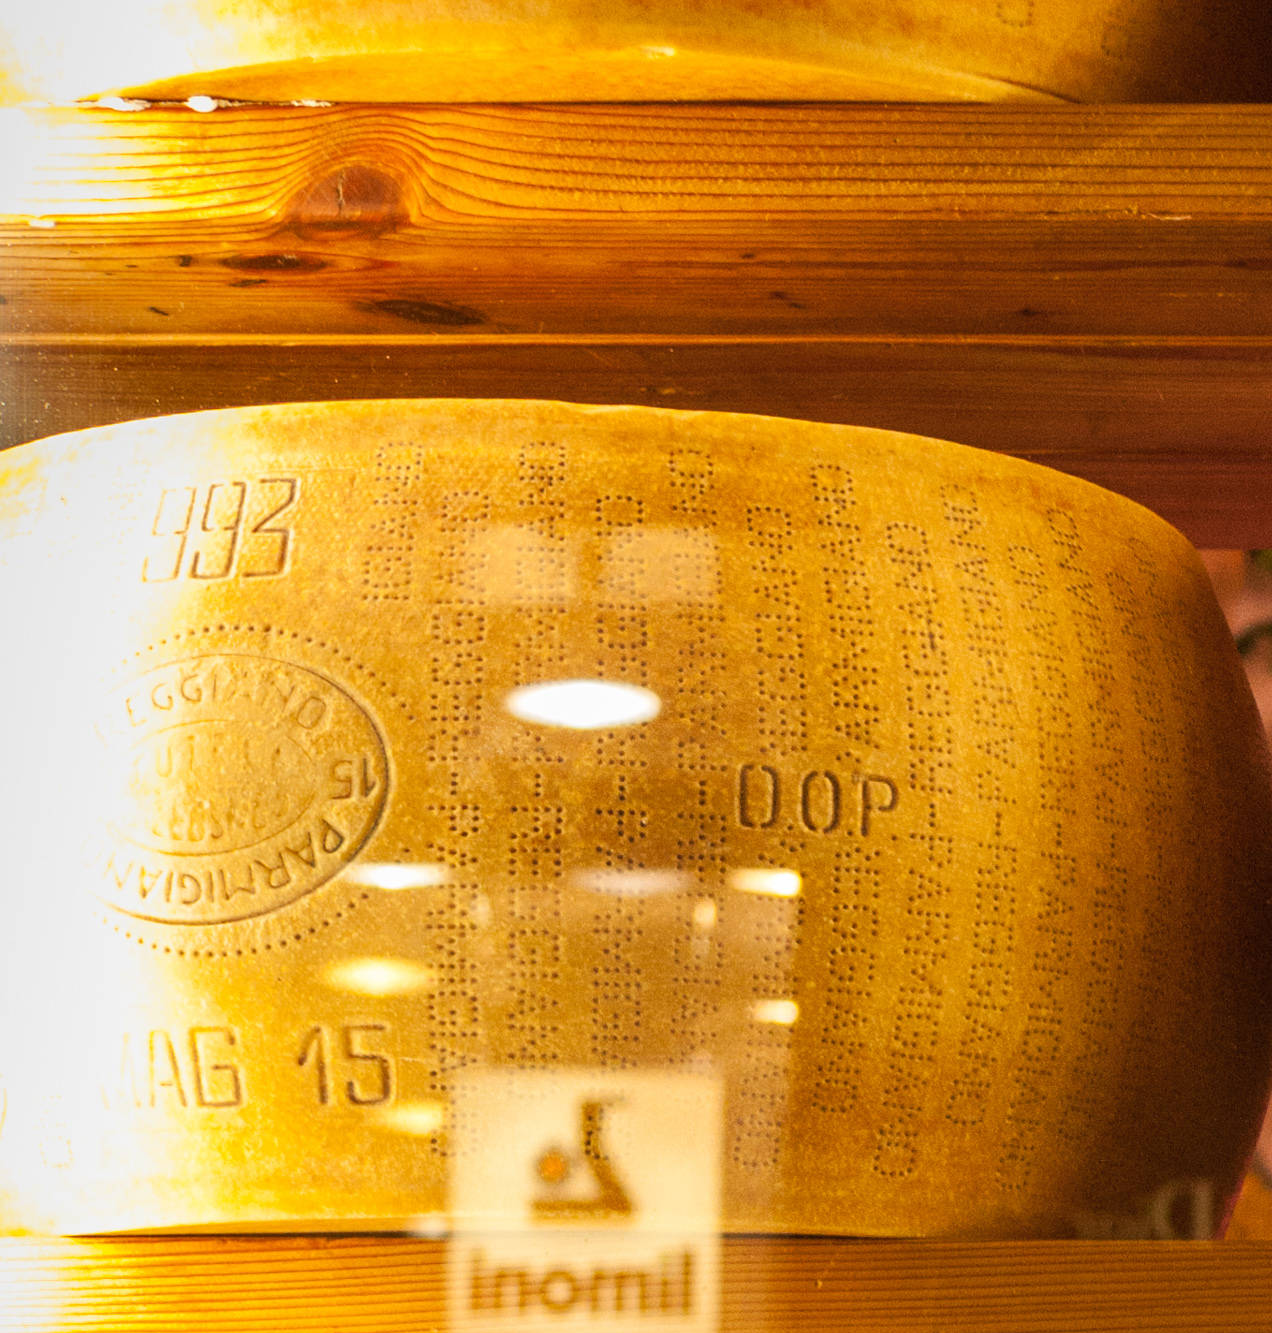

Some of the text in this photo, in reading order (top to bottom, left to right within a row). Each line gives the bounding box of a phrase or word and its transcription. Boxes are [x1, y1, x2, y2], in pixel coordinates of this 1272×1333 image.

[142, 477, 299, 583] 993
[120, 660, 328, 732] EGGIANO
[100, 818, 346, 906] PARMIGIAN
[297, 1024, 392, 1106] 15
